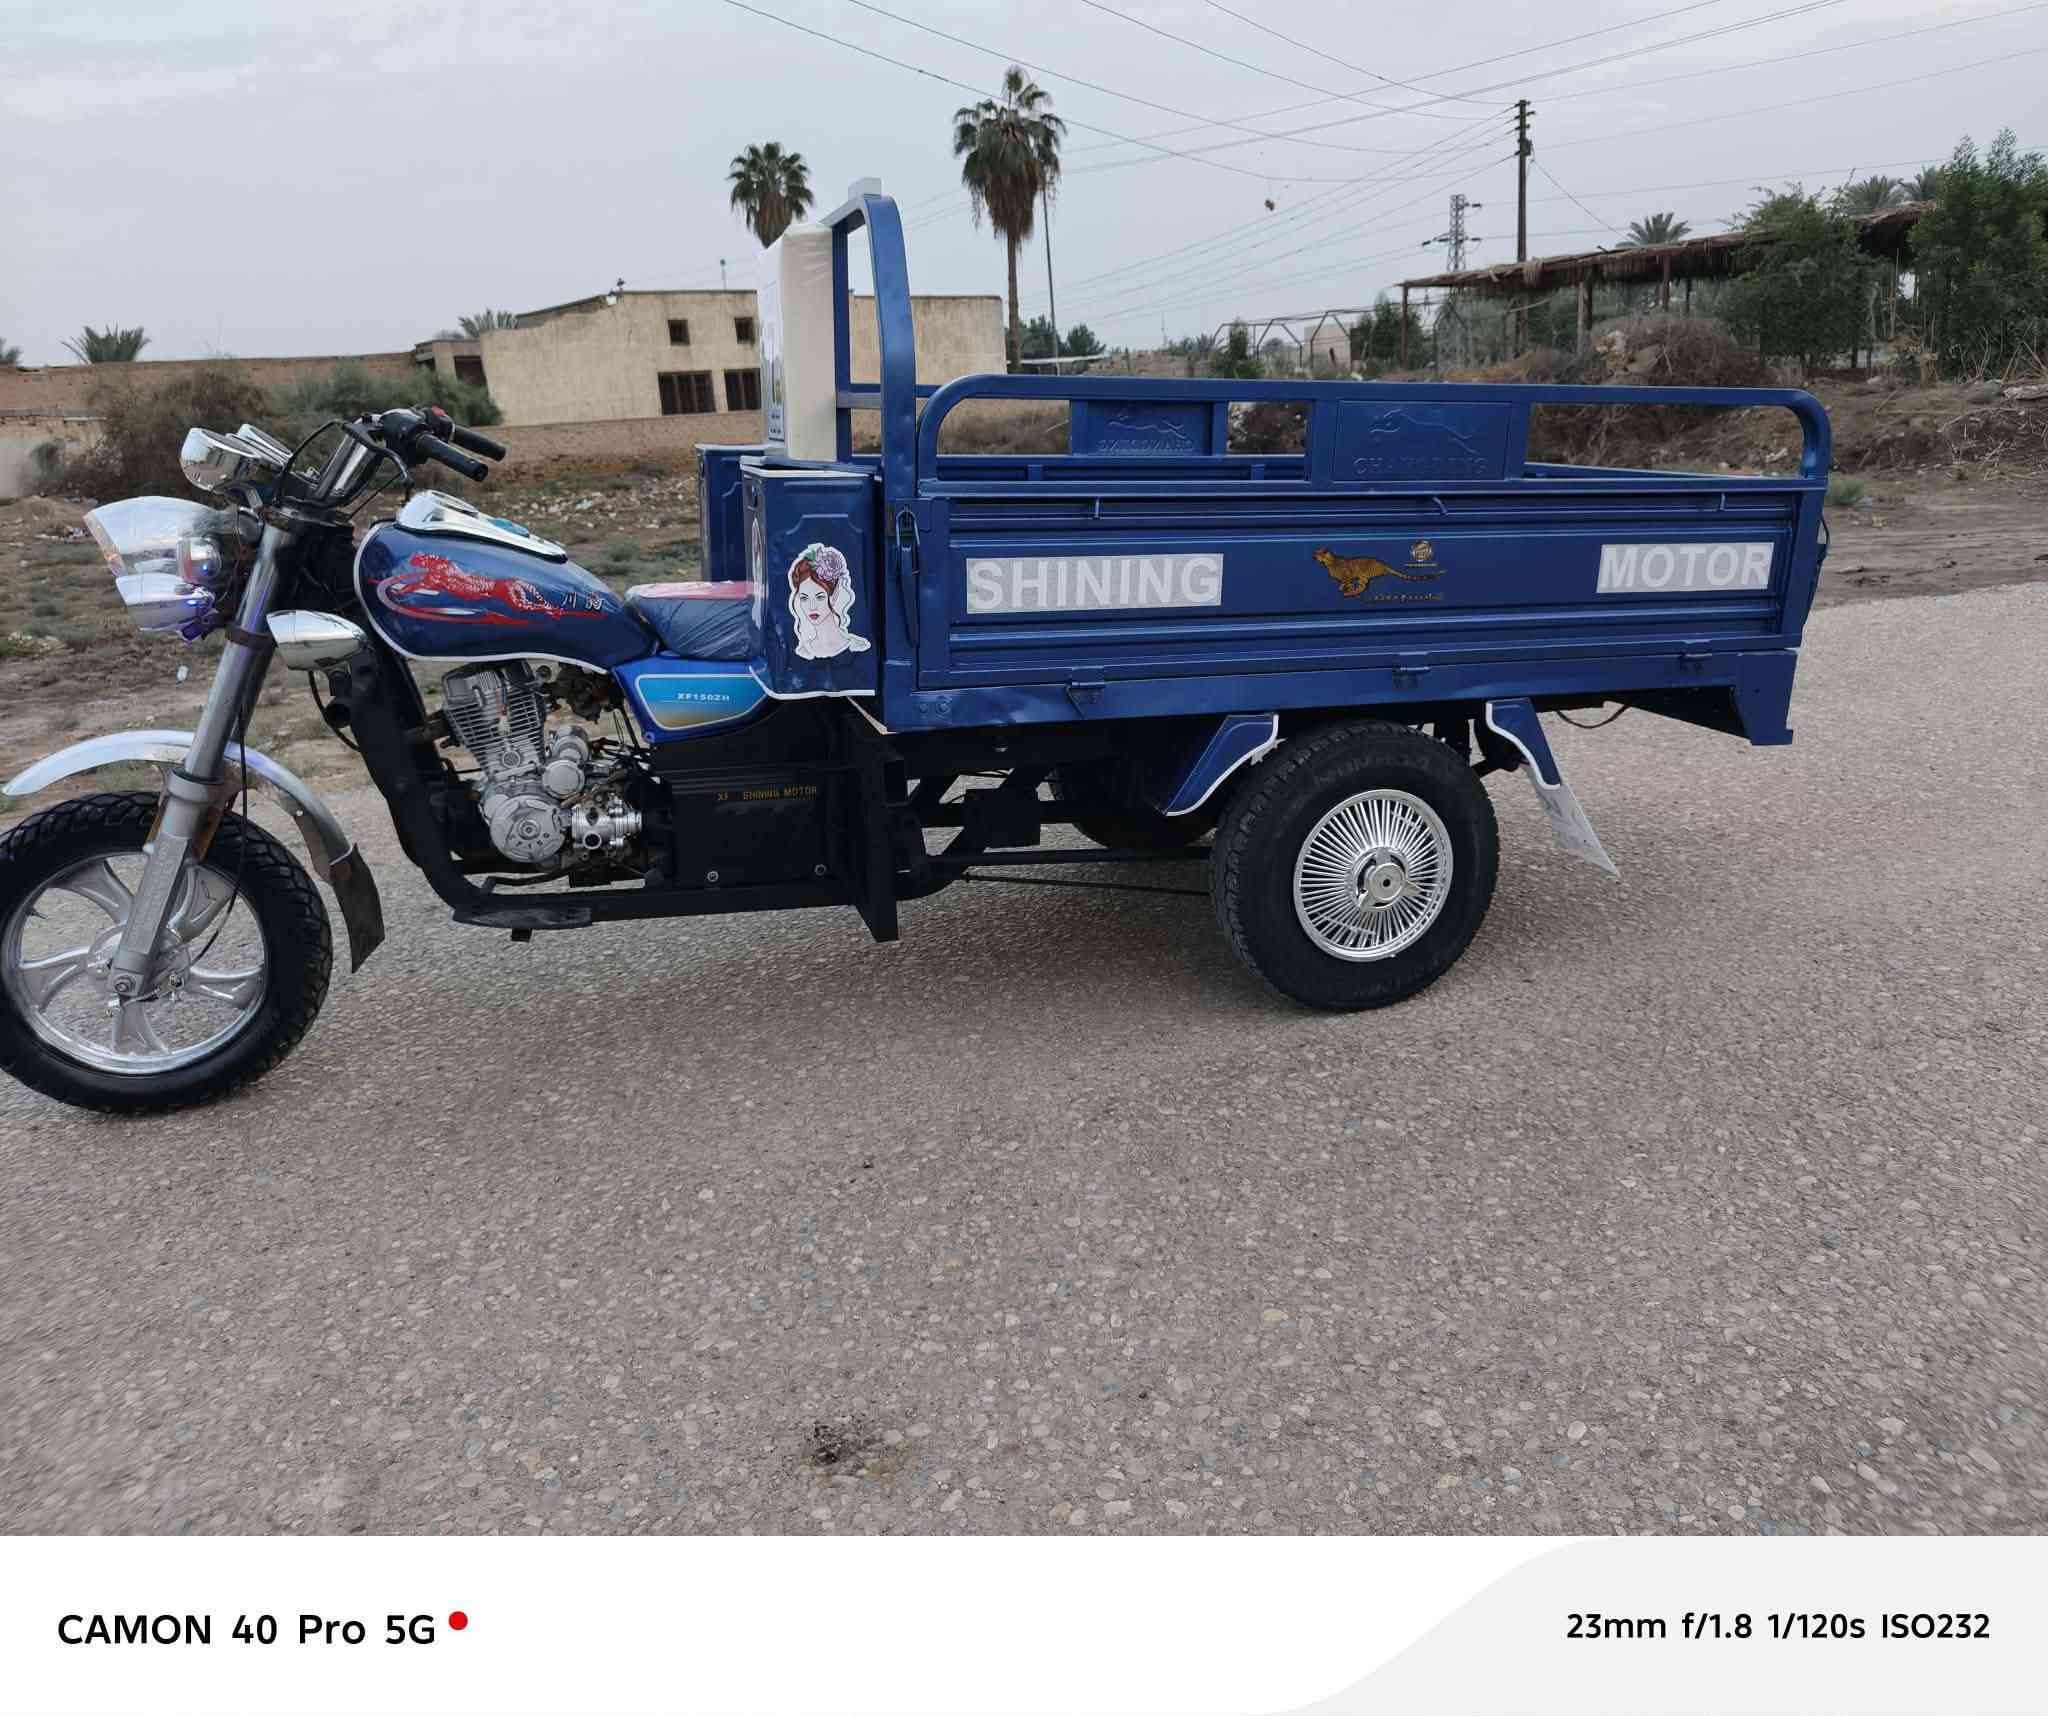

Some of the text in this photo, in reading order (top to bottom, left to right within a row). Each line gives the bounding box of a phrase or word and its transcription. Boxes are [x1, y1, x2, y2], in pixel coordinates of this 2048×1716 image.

[1600, 545, 1769, 588] MOTOR
[967, 555, 1221, 610] SHINING
[677, 692, 730, 702] XF150ZH
[784, 785, 817, 797] MOTOR
